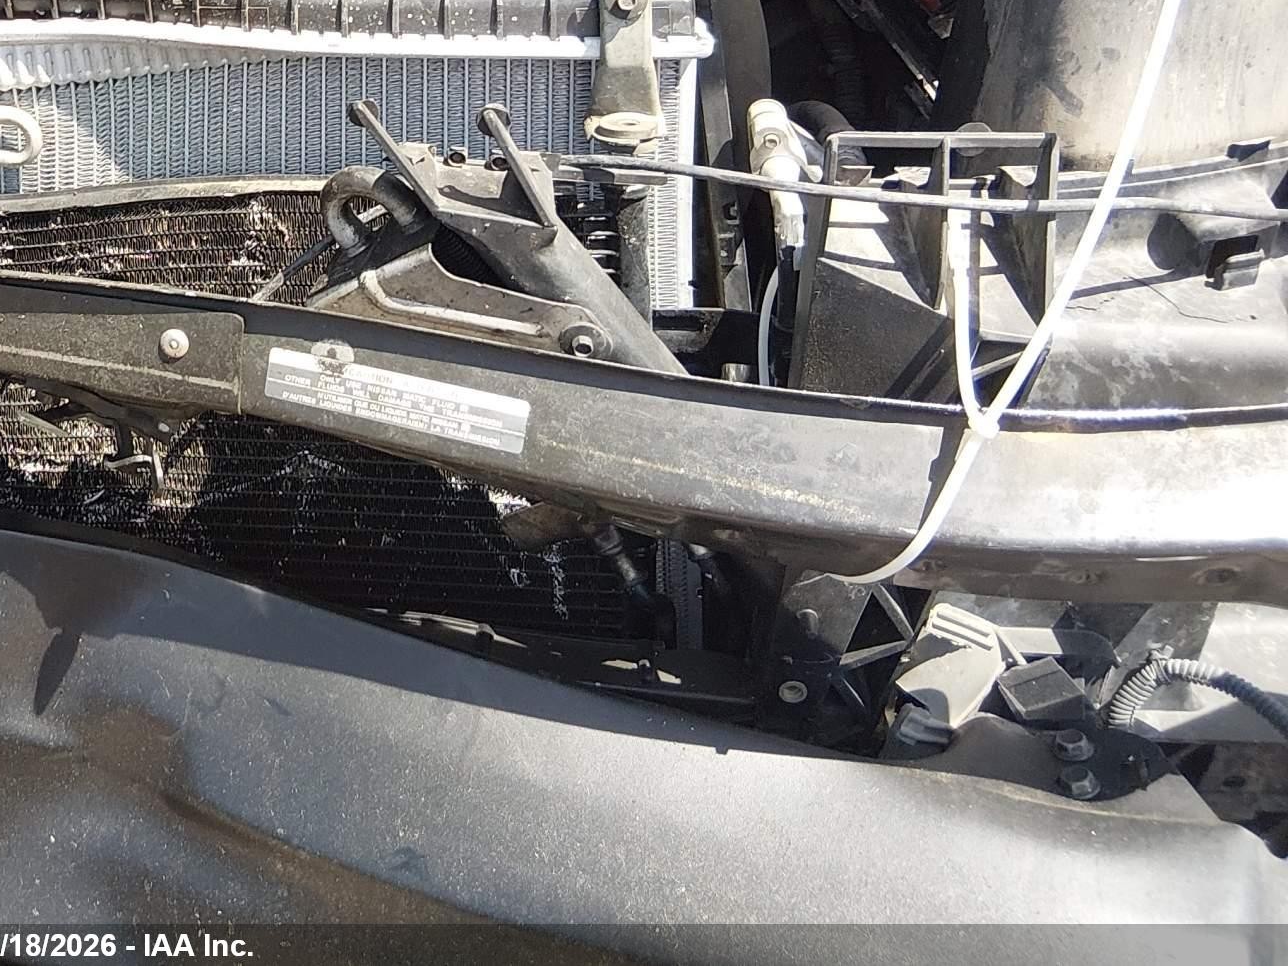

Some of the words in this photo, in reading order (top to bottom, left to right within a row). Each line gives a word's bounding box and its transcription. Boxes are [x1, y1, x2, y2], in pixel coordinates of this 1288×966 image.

[284, 373, 310, 386] OTHER
[317, 380, 344, 393] FLUIDS
[351, 387, 370, 399] WILL
[377, 393, 412, 408] DAMAGE
[319, 373, 341, 384] ONLY
[345, 379, 361, 389] USE
[367, 384, 397, 397] NISSAN
[431, 397, 456, 409] FLUID
